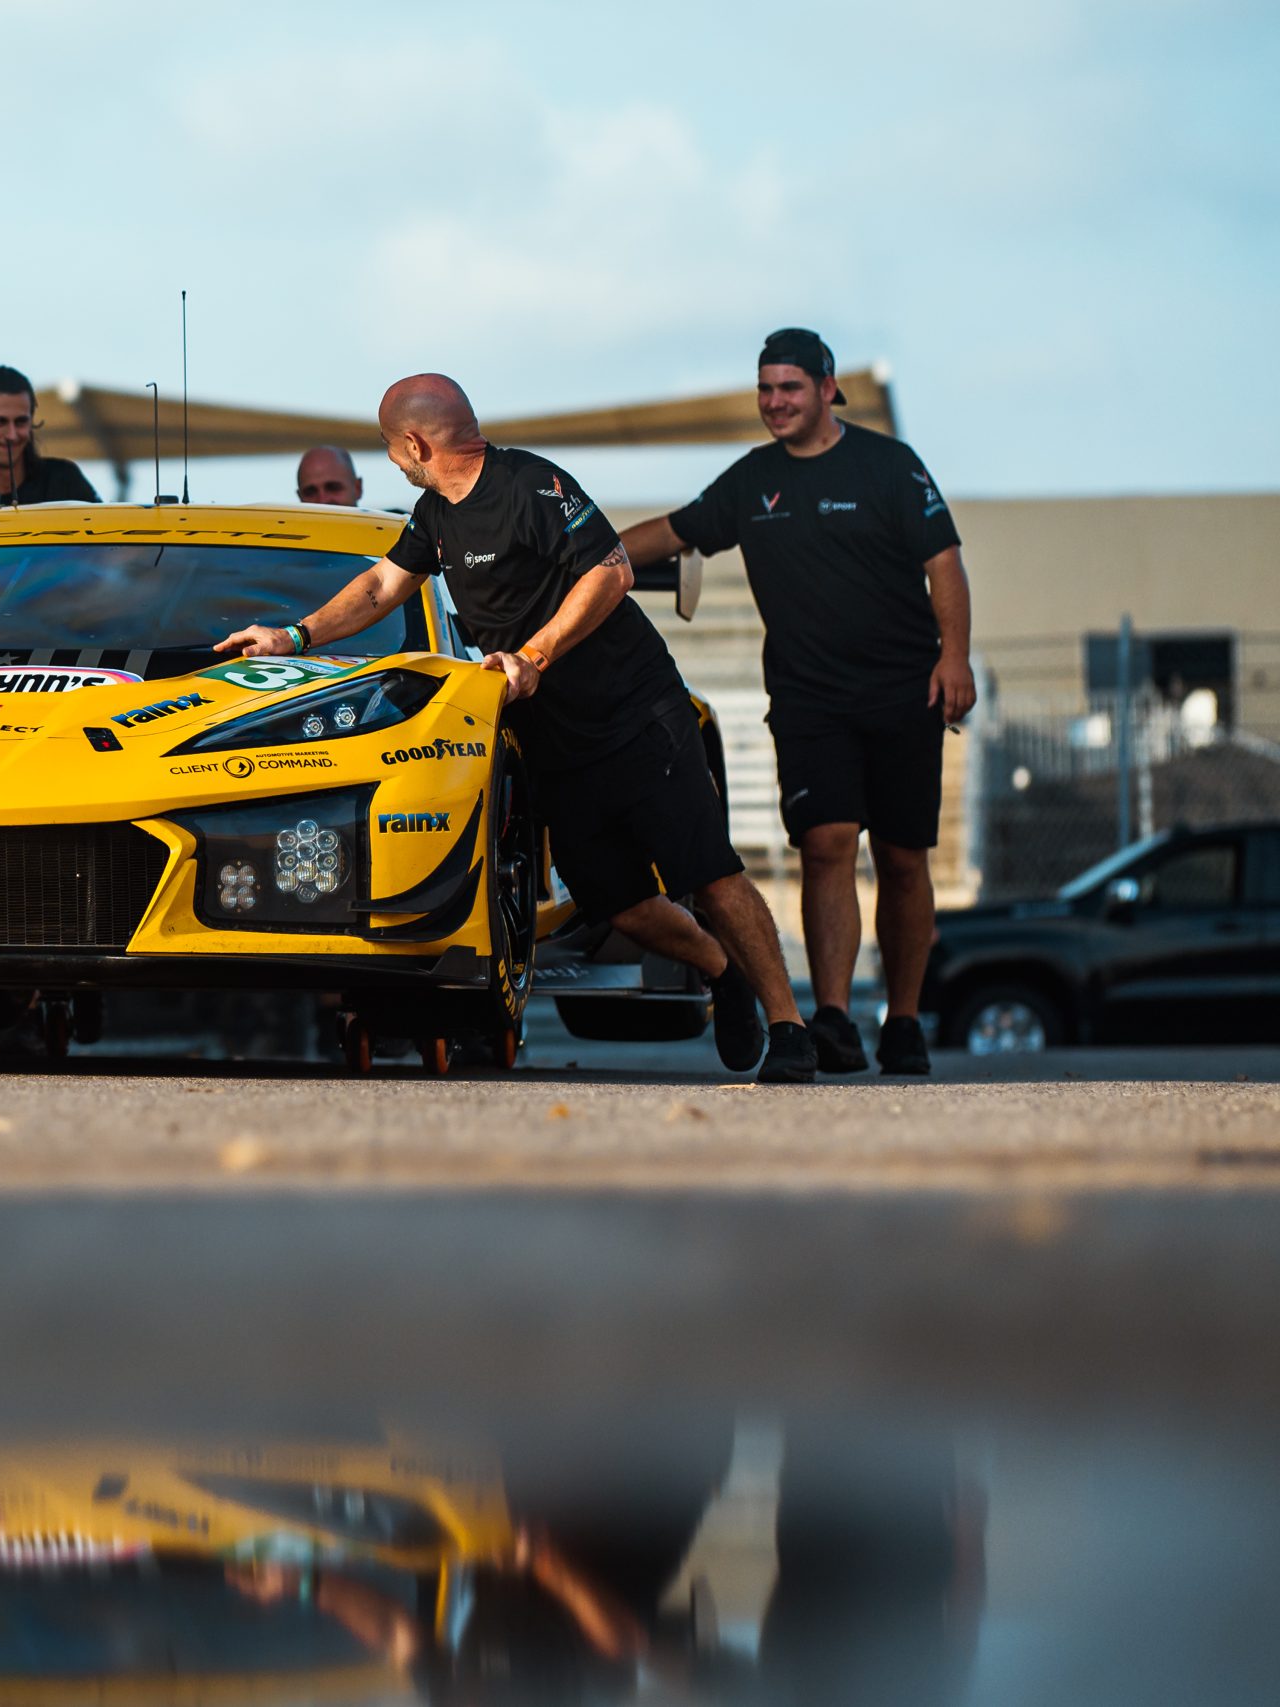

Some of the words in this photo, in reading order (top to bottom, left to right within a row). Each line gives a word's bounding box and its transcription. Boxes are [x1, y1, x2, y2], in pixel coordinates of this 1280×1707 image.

[474, 553, 496, 564] SPORT
[381, 739, 487, 765] GOODYEAR
[169, 763, 219, 775] CLIENT
